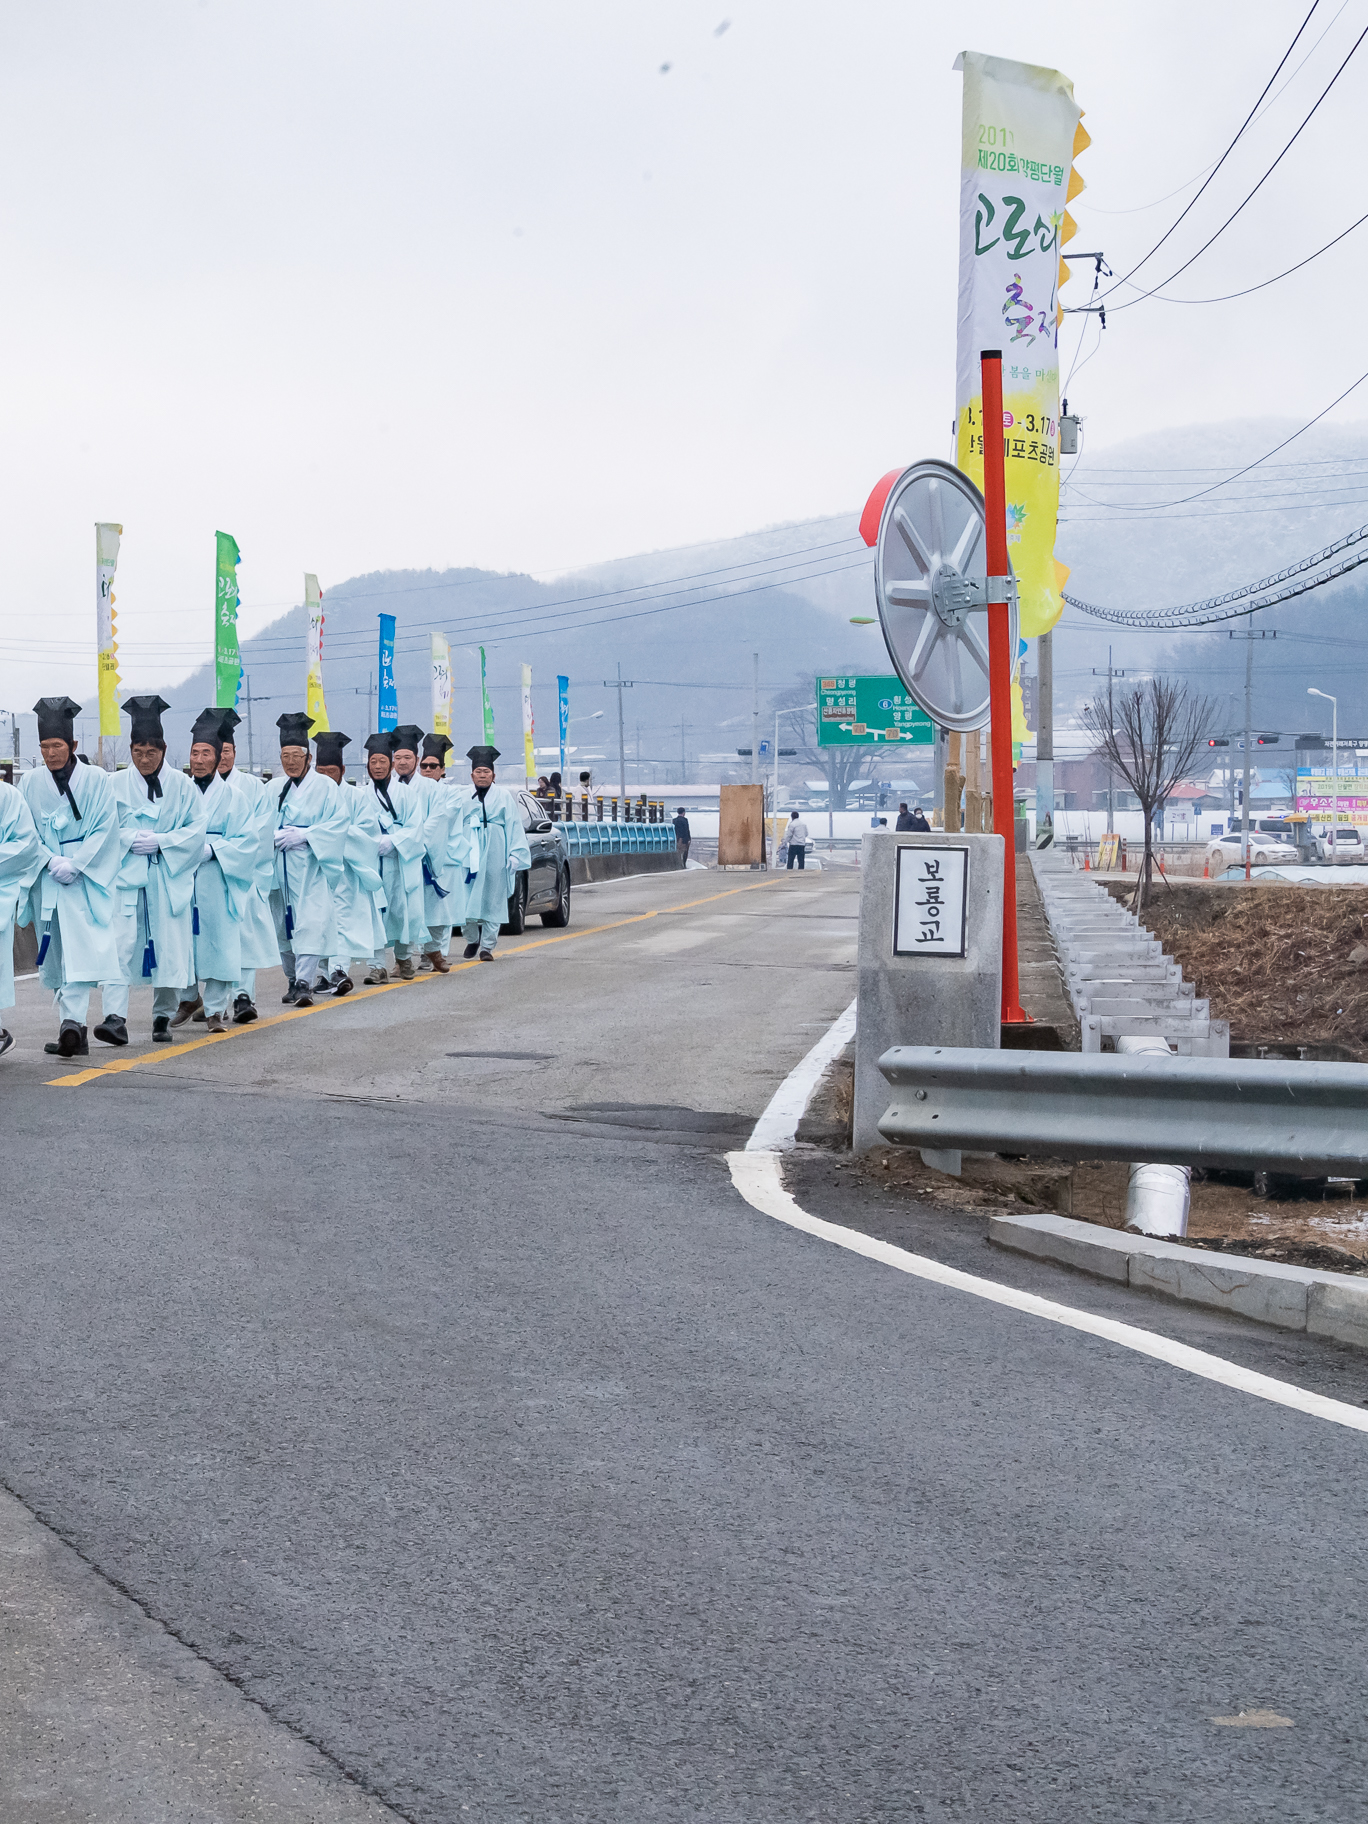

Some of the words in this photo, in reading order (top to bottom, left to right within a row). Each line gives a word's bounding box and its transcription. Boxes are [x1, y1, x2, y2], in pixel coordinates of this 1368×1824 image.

[1026, 414, 1050, 436] 3.17
[970, 434, 1055, 467] 포츠공원
[914, 859, 945, 943] 보룡교
